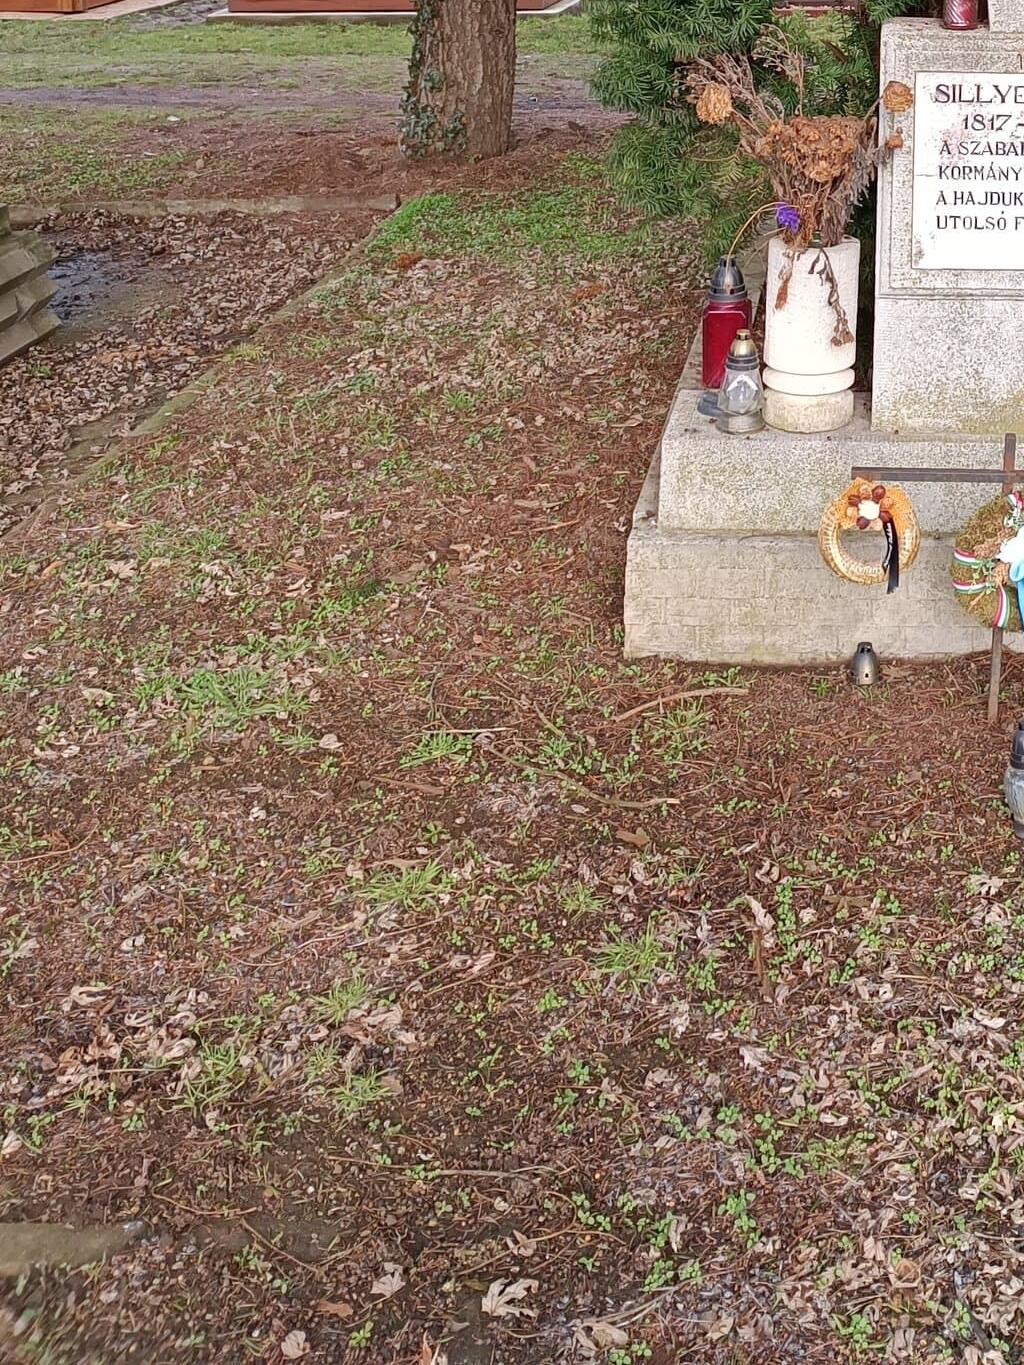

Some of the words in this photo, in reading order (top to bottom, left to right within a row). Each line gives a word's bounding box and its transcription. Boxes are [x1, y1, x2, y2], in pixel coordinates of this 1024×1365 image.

[939, 140, 952, 155] A
[936, 190, 948, 205] A
[936, 211, 1007, 230] UTOLSÓ
